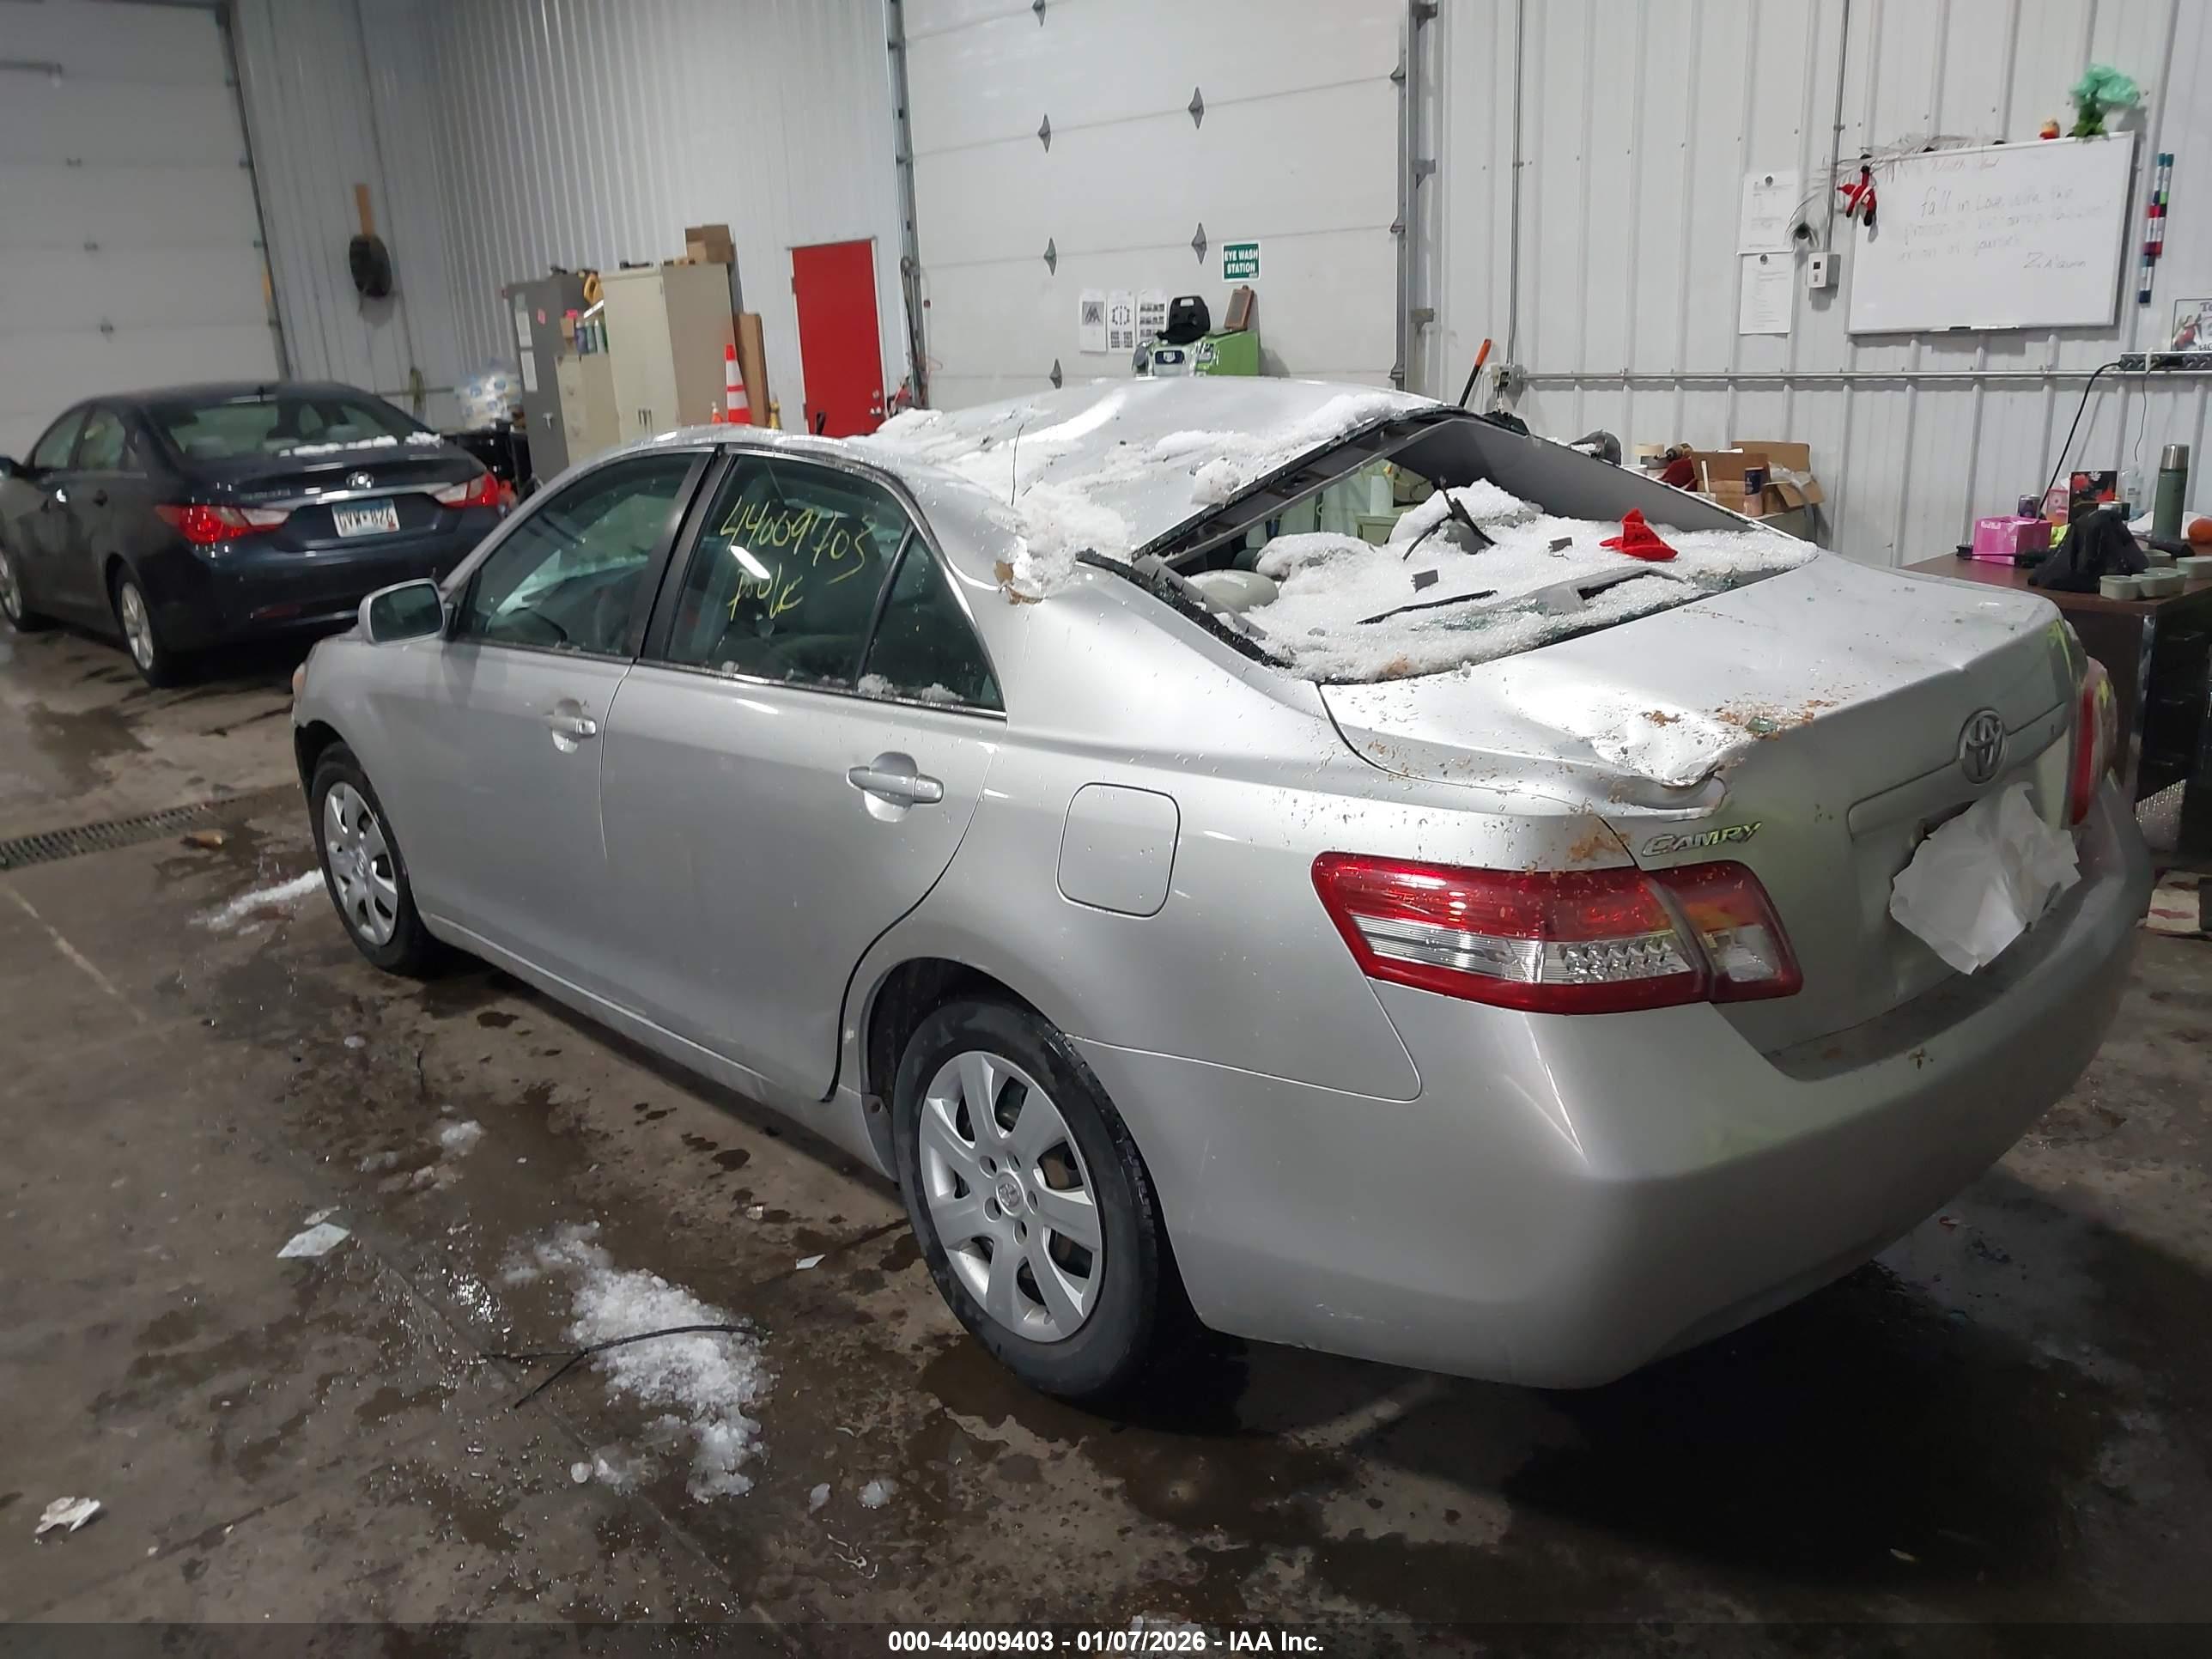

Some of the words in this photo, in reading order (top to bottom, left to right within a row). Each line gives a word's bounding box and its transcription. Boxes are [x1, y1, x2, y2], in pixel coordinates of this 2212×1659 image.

[1224, 250, 1237, 261] EYE
[1238, 247, 1258, 261] WASH
[1227, 262, 1255, 275] STATION
[1642, 822, 1763, 857] CAMRY
